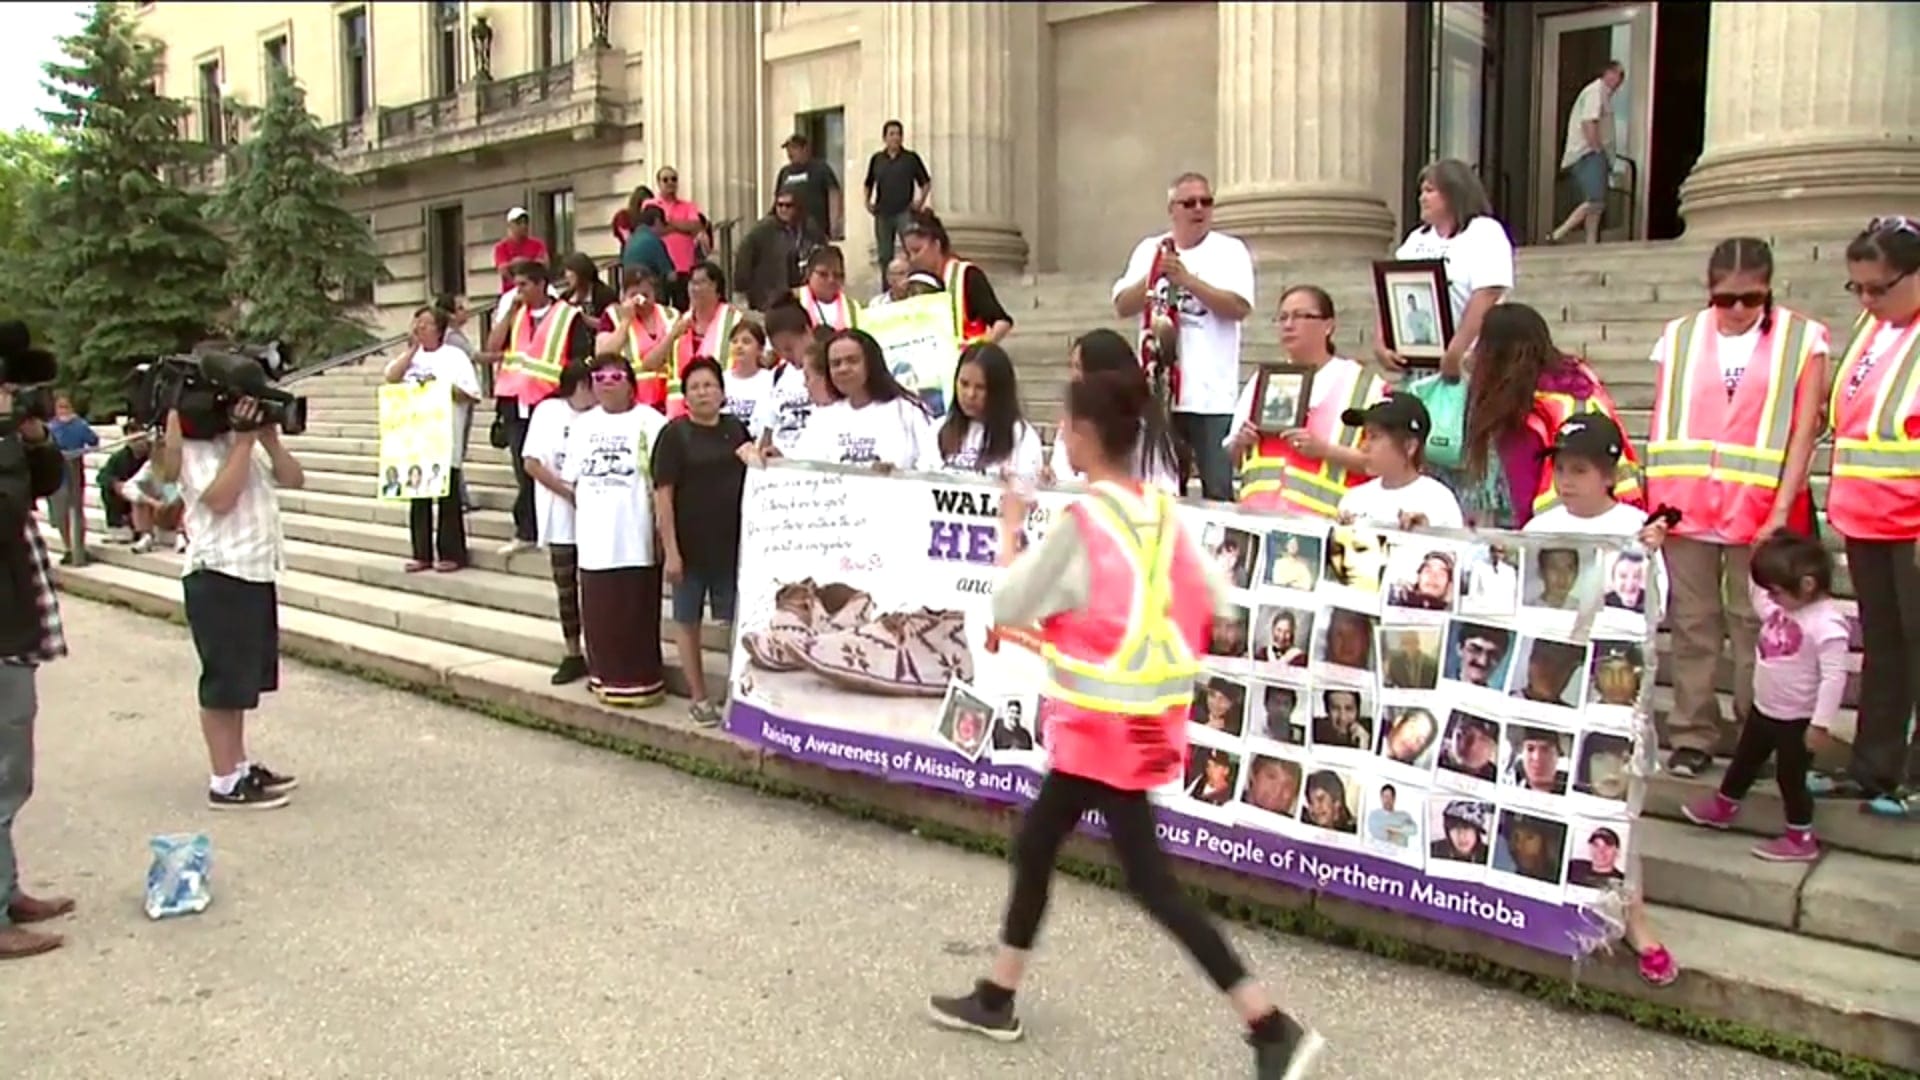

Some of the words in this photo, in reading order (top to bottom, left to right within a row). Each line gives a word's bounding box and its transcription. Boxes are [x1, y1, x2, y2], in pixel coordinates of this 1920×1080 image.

[931, 488, 1004, 518] WAL
[761, 720, 801, 753] Raising
[805, 734, 889, 767] Awareness
[892, 751, 912, 770] of
[914, 754, 976, 788] Missing
[980, 771, 1012, 791] and
[1195, 828, 1264, 863] People
[1269, 850, 1294, 870] of
[1299, 853, 1404, 897] Northern
[1410, 879, 1525, 929] Manitoba
